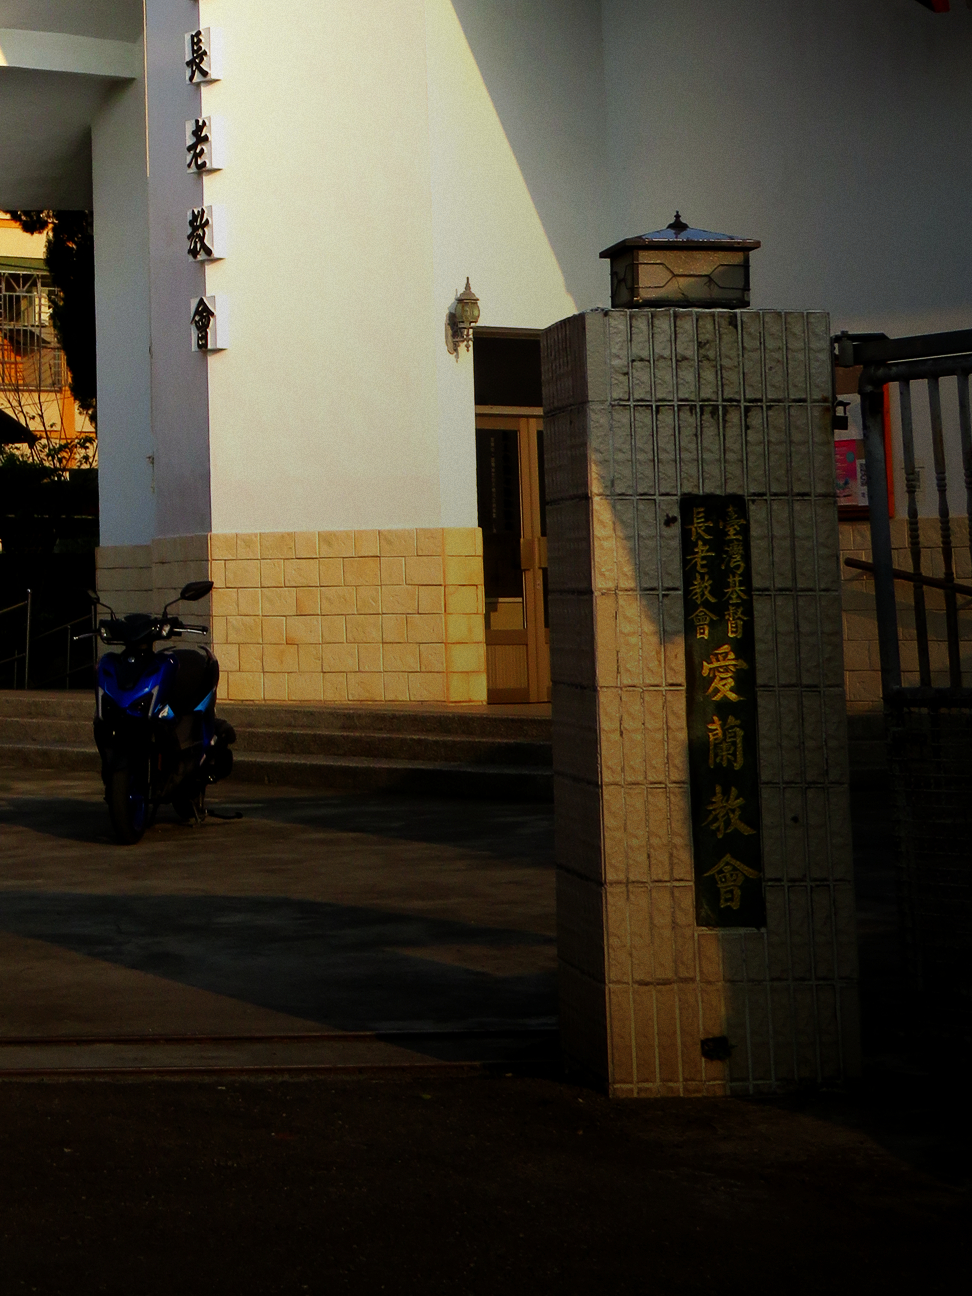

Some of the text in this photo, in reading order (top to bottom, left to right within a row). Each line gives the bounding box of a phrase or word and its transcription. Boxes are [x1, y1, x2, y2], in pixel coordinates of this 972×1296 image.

[684, 507, 720, 640] 長老教會
[719, 505, 751, 639] 臺灣基督
[702, 643, 761, 910] 愛蘭教會
